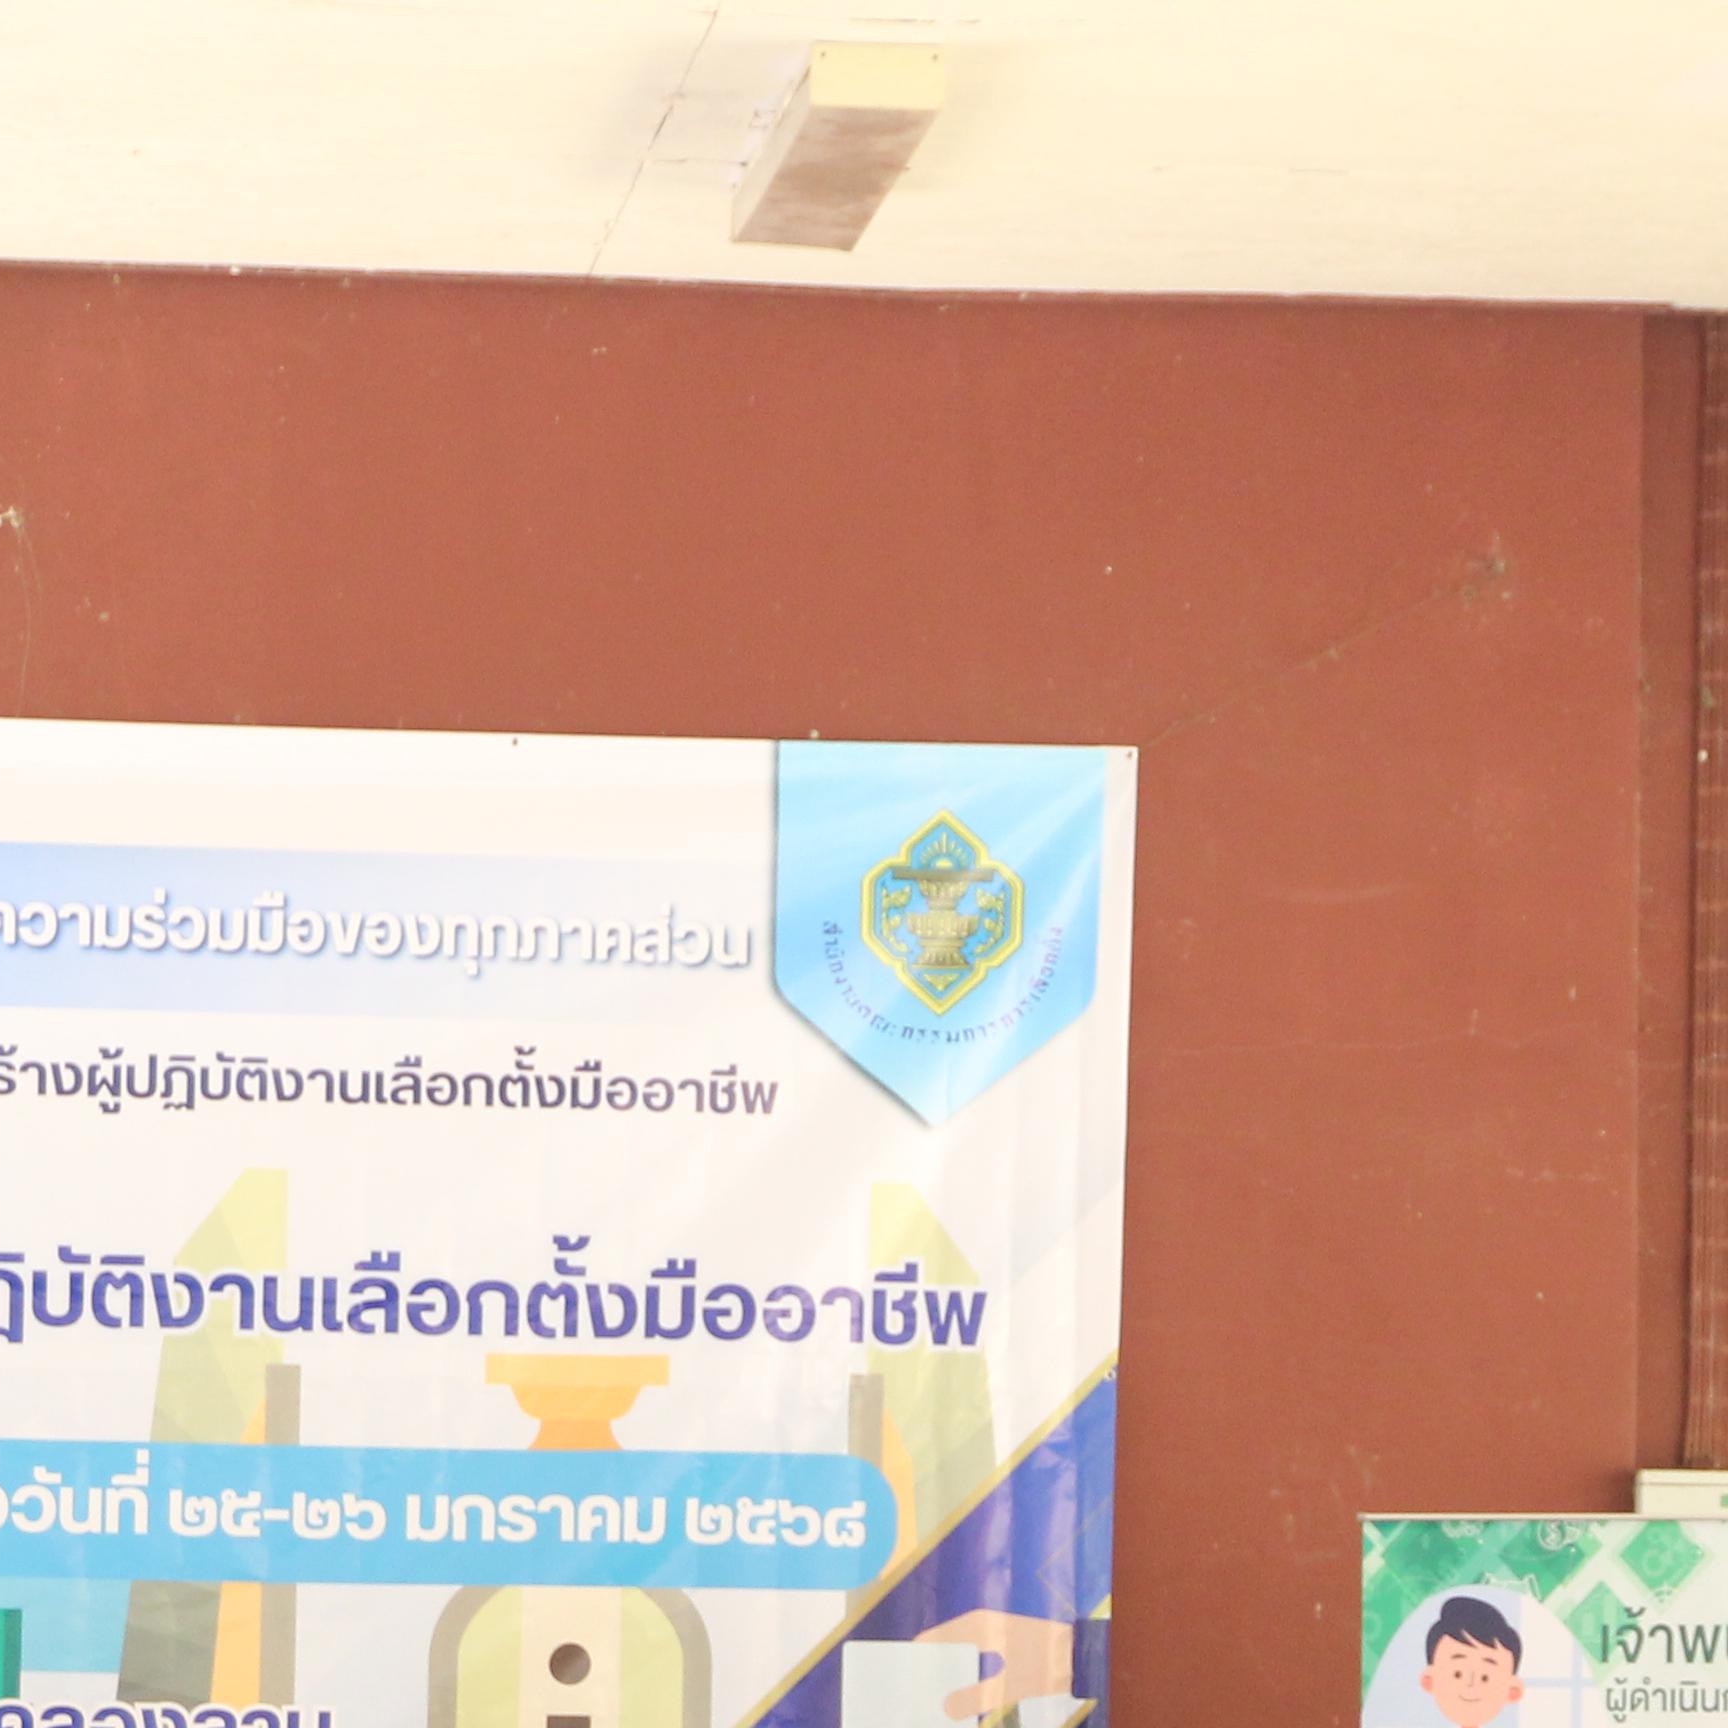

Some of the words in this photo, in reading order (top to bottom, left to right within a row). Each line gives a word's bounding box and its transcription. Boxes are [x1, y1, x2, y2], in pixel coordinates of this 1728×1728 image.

[408, 1492, 667, 1545] มกราคม
[683, 1492, 866, 1549] ๒๕๖๘
